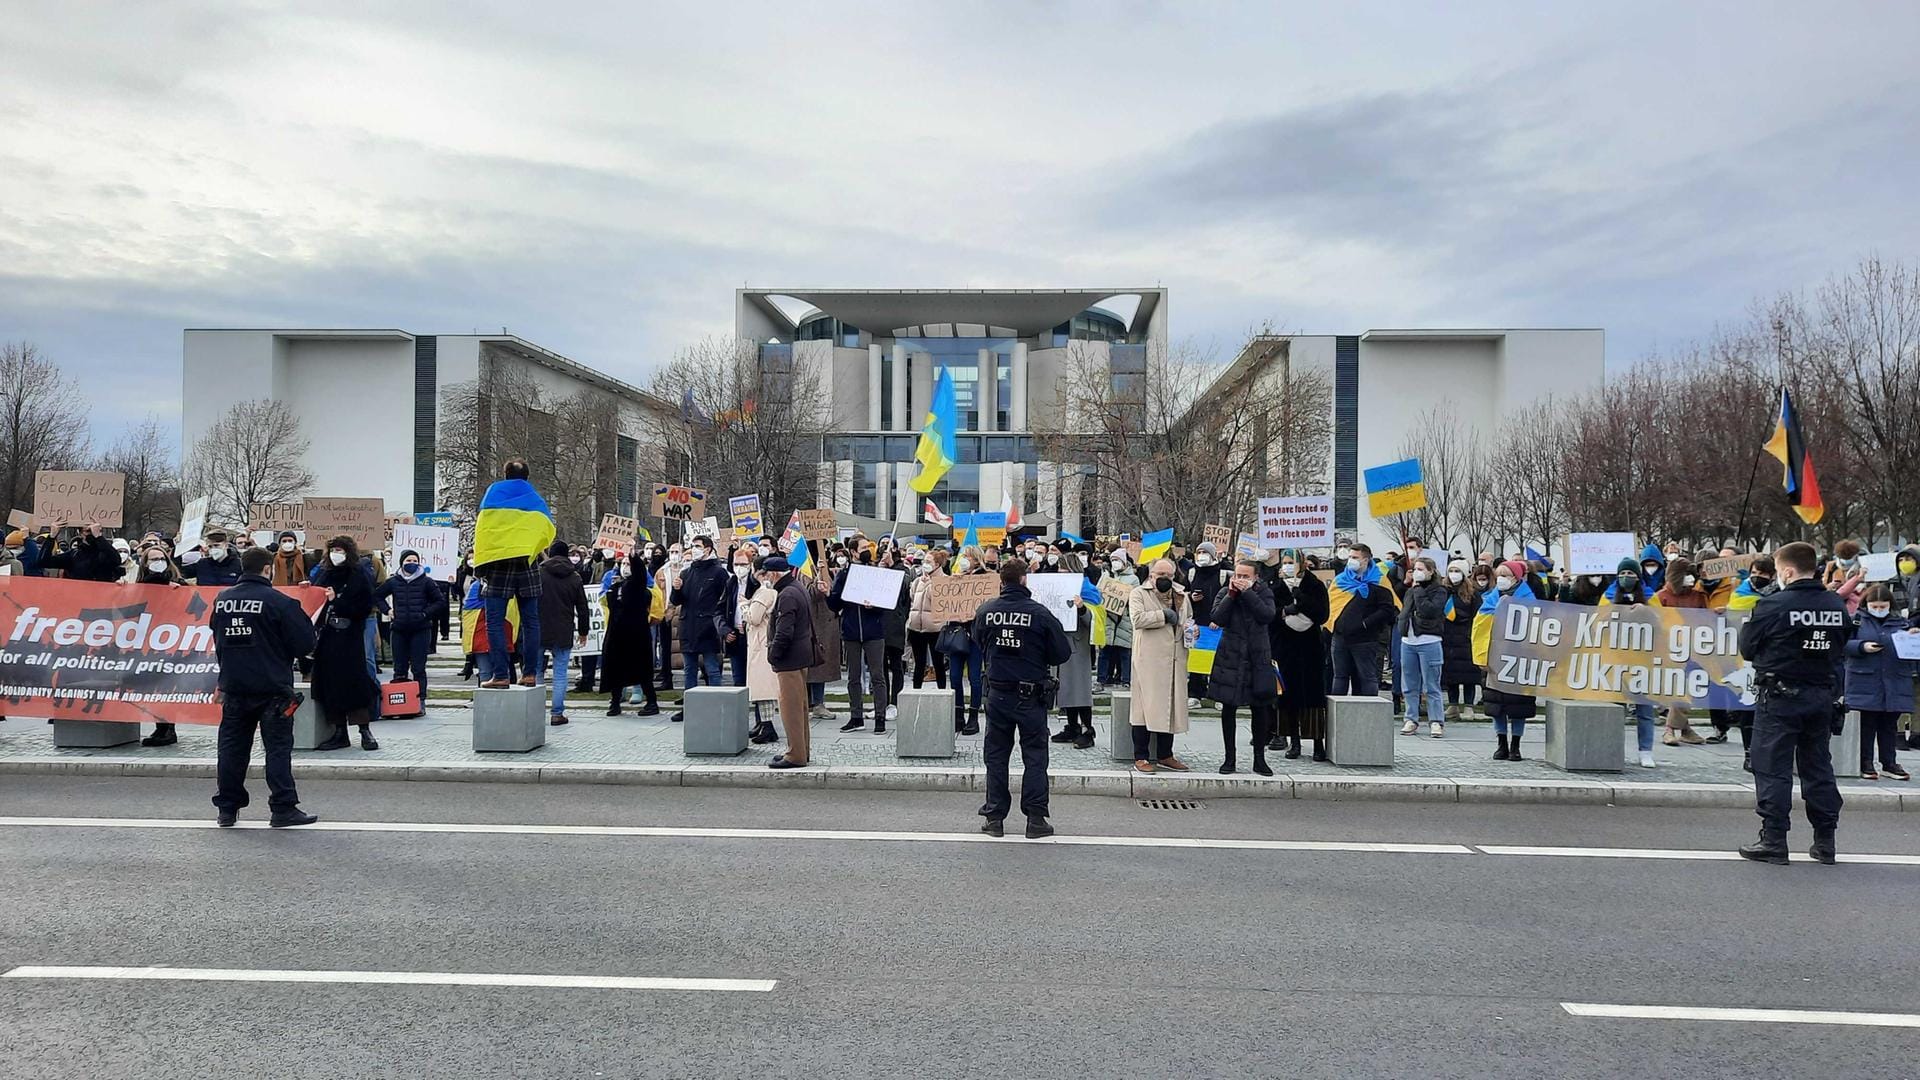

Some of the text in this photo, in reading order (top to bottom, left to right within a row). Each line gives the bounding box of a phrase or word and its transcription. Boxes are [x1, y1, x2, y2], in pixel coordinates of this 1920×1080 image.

[39, 474, 121, 497] Stop Putin
[667, 487, 690, 504] NO
[40, 501, 73, 520] Stop
[249, 503, 304, 520] STOP PUTI
[662, 502, 692, 521] WAR
[1263, 505, 1276, 515] You
[1277, 505, 1294, 514] have
[1320, 504, 1329, 514] up
[259, 520, 305, 529] ACT NOW
[416, 517, 430, 526] WE
[605, 514, 633, 529] TAKE
[1263, 517, 1279, 527] with
[1279, 516, 1291, 526] the
[601, 526, 633, 537] ACTION
[1205, 526, 1230, 537] STOP
[1285, 530, 1300, 538] fuck
[600, 539, 624, 550] NOW
[215, 600, 264, 614] POLIZEI
[1101, 593, 1125, 613] TOP
[231, 617, 245, 627] BE
[985, 611, 1032, 627] POLIZEI
[1789, 610, 1843, 627] POLIZEI
[224, 627, 253, 636] 21319
[1001, 629, 1015, 639] BE
[1504, 603, 1749, 663] Die Krim geh
[1812, 630, 1827, 640] BE
[995, 637, 1021, 648] 21313
[1802, 639, 1831, 650] 21316
[24, 652, 53, 666] all
[52, 655, 134, 671] political
[135, 659, 221, 674] prisoners
[1497, 652, 1710, 698] zur Ukraine
[54, 688, 95, 700] AGAINST
[96, 690, 120, 701] WAR
[121, 691, 141, 702] AND
